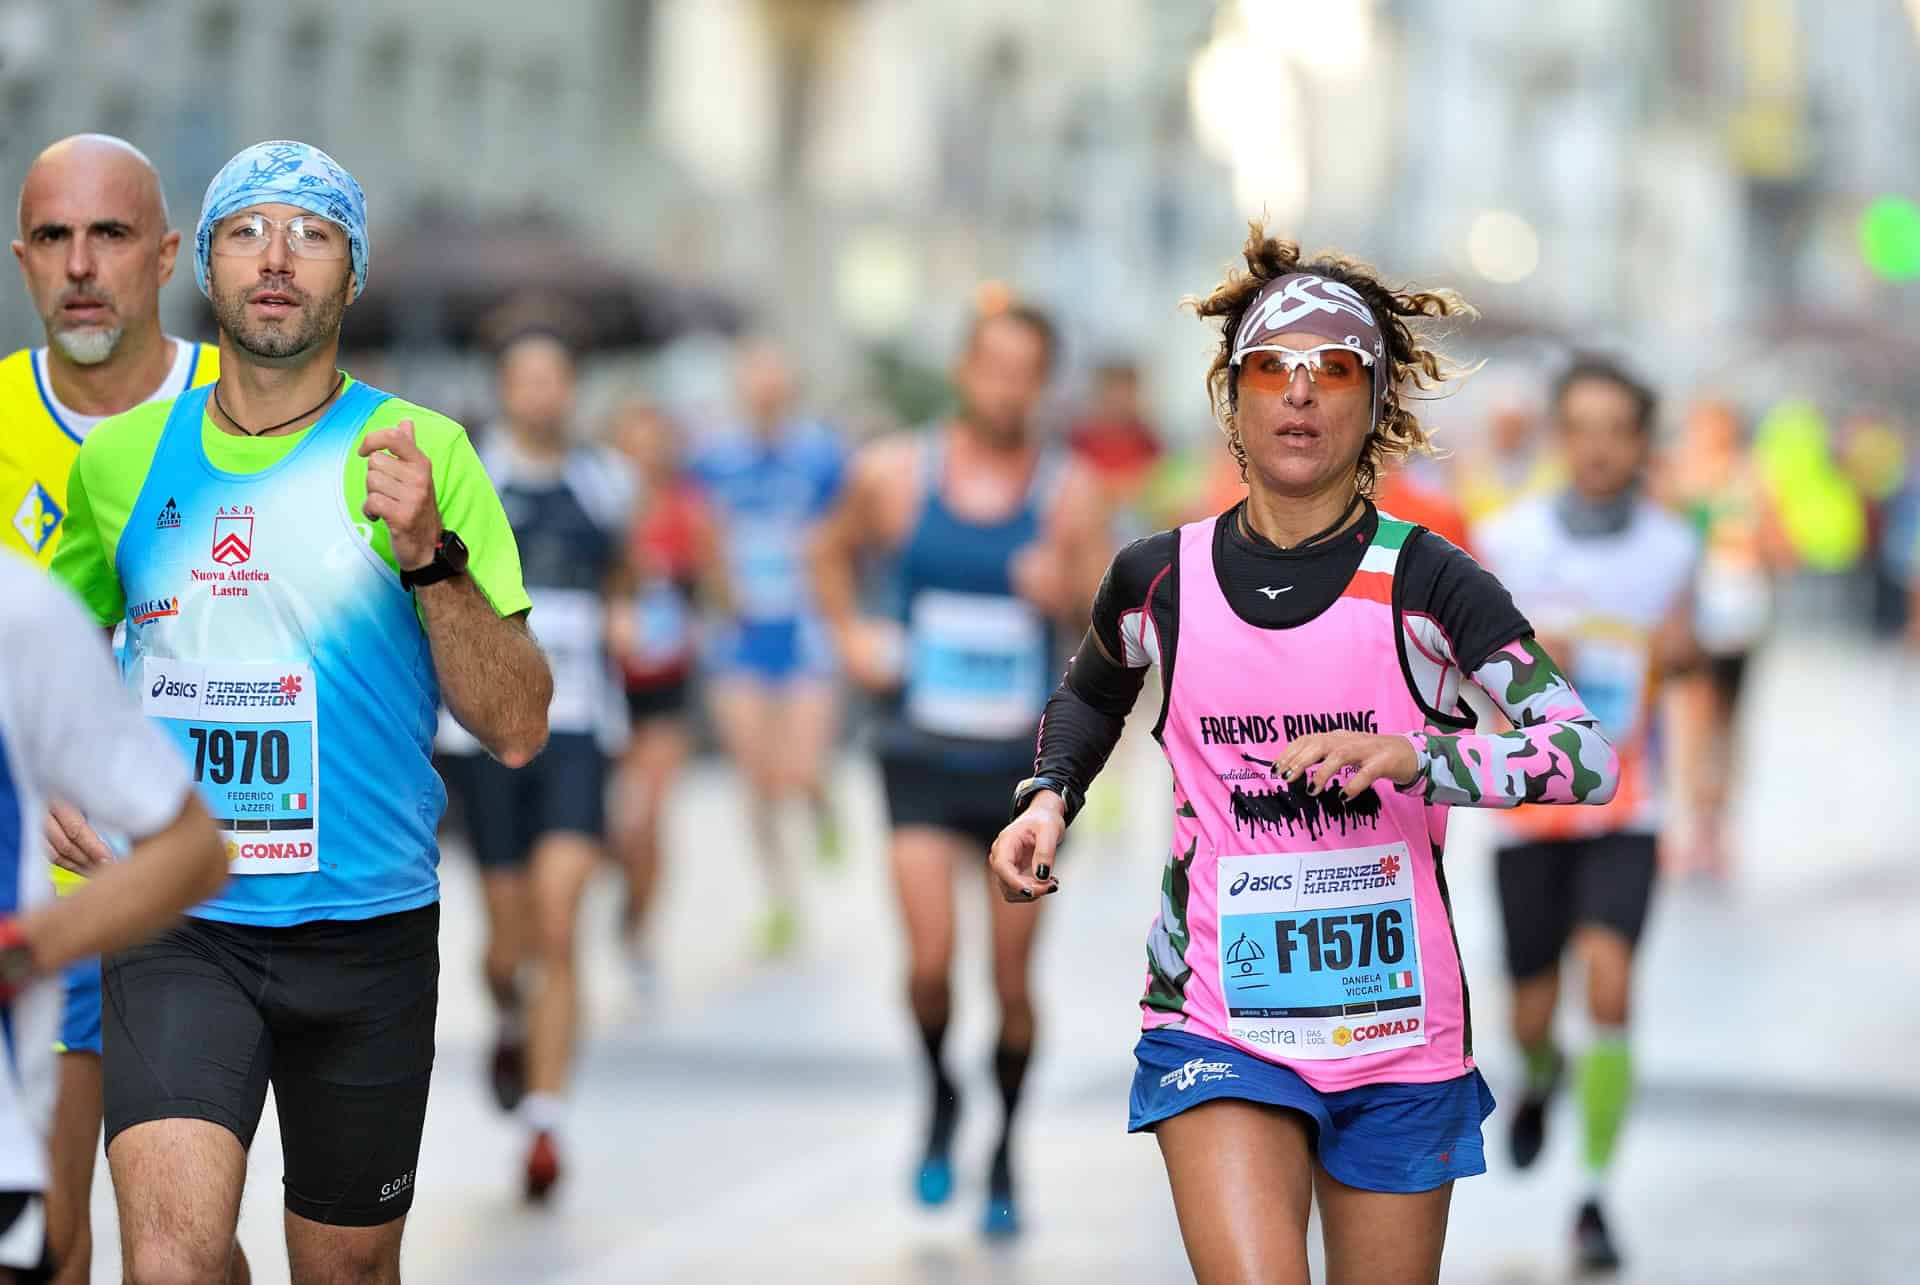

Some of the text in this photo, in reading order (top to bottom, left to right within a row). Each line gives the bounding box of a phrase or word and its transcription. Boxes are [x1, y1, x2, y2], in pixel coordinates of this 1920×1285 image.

[191, 569, 270, 581] Nuova Atletica
[212, 584, 248, 596] Lastra
[206, 681, 282, 694] FIRENZE
[204, 694, 297, 707] MARATHON
[1200, 710, 1378, 745] FRIENDS RUNNING
[189, 727, 290, 785] 7970
[227, 792, 274, 801] FEDERICO
[234, 803, 274, 812] LAZZERI
[240, 842, 313, 859] CONAD
[1305, 863, 1383, 881] FIRENZE
[1303, 874, 1397, 895] MARATHON
[1275, 908, 1405, 974] F1576
[1342, 973, 1381, 986] DANIELA
[1346, 984, 1383, 997] VICCARI
[1247, 1027, 1296, 1045] estra
[1353, 1018, 1420, 1042] CONAD
